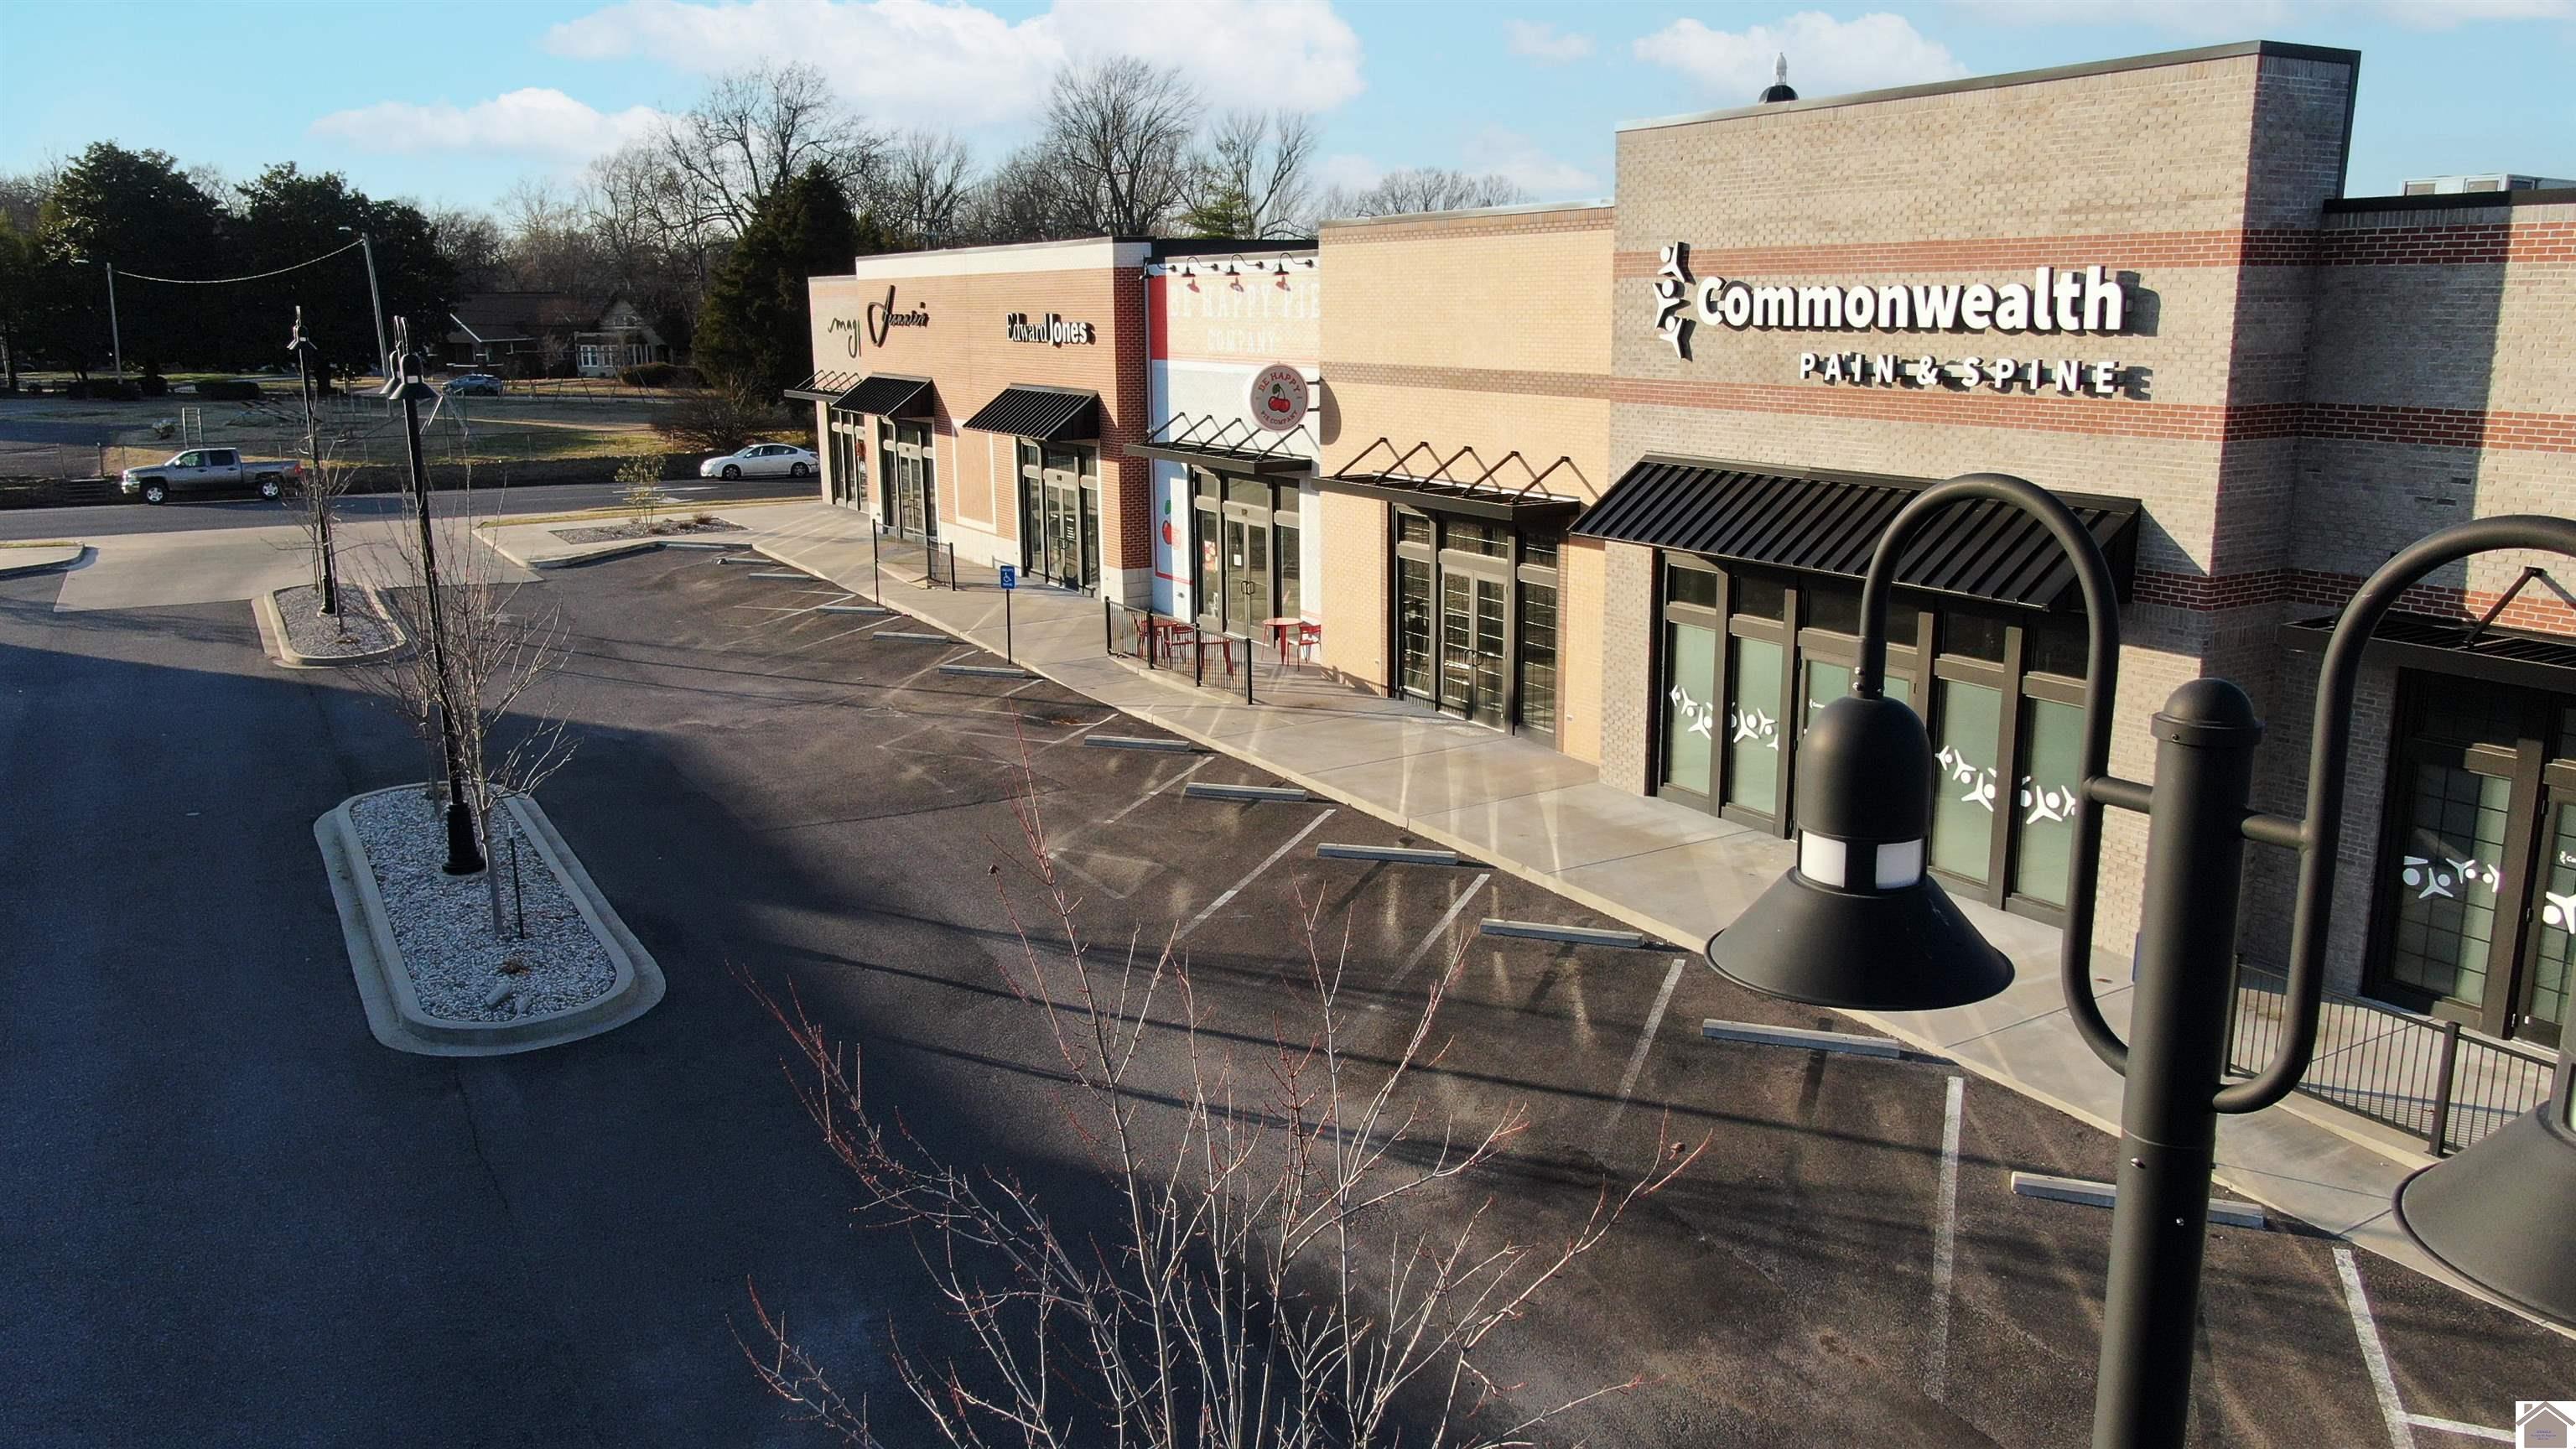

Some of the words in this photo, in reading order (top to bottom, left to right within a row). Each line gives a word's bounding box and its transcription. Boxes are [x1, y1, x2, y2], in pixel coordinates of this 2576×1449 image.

[1696, 266, 2127, 331] Commonwealth
[1006, 312, 1048, 343] Edward
[1048, 313, 1088, 346] Jones
[1270, 372, 1301, 392] HAPPY
[1800, 352, 1895, 384] PAIN
[1915, 355, 1939, 386] &
[1963, 356, 2120, 393] SPINE
